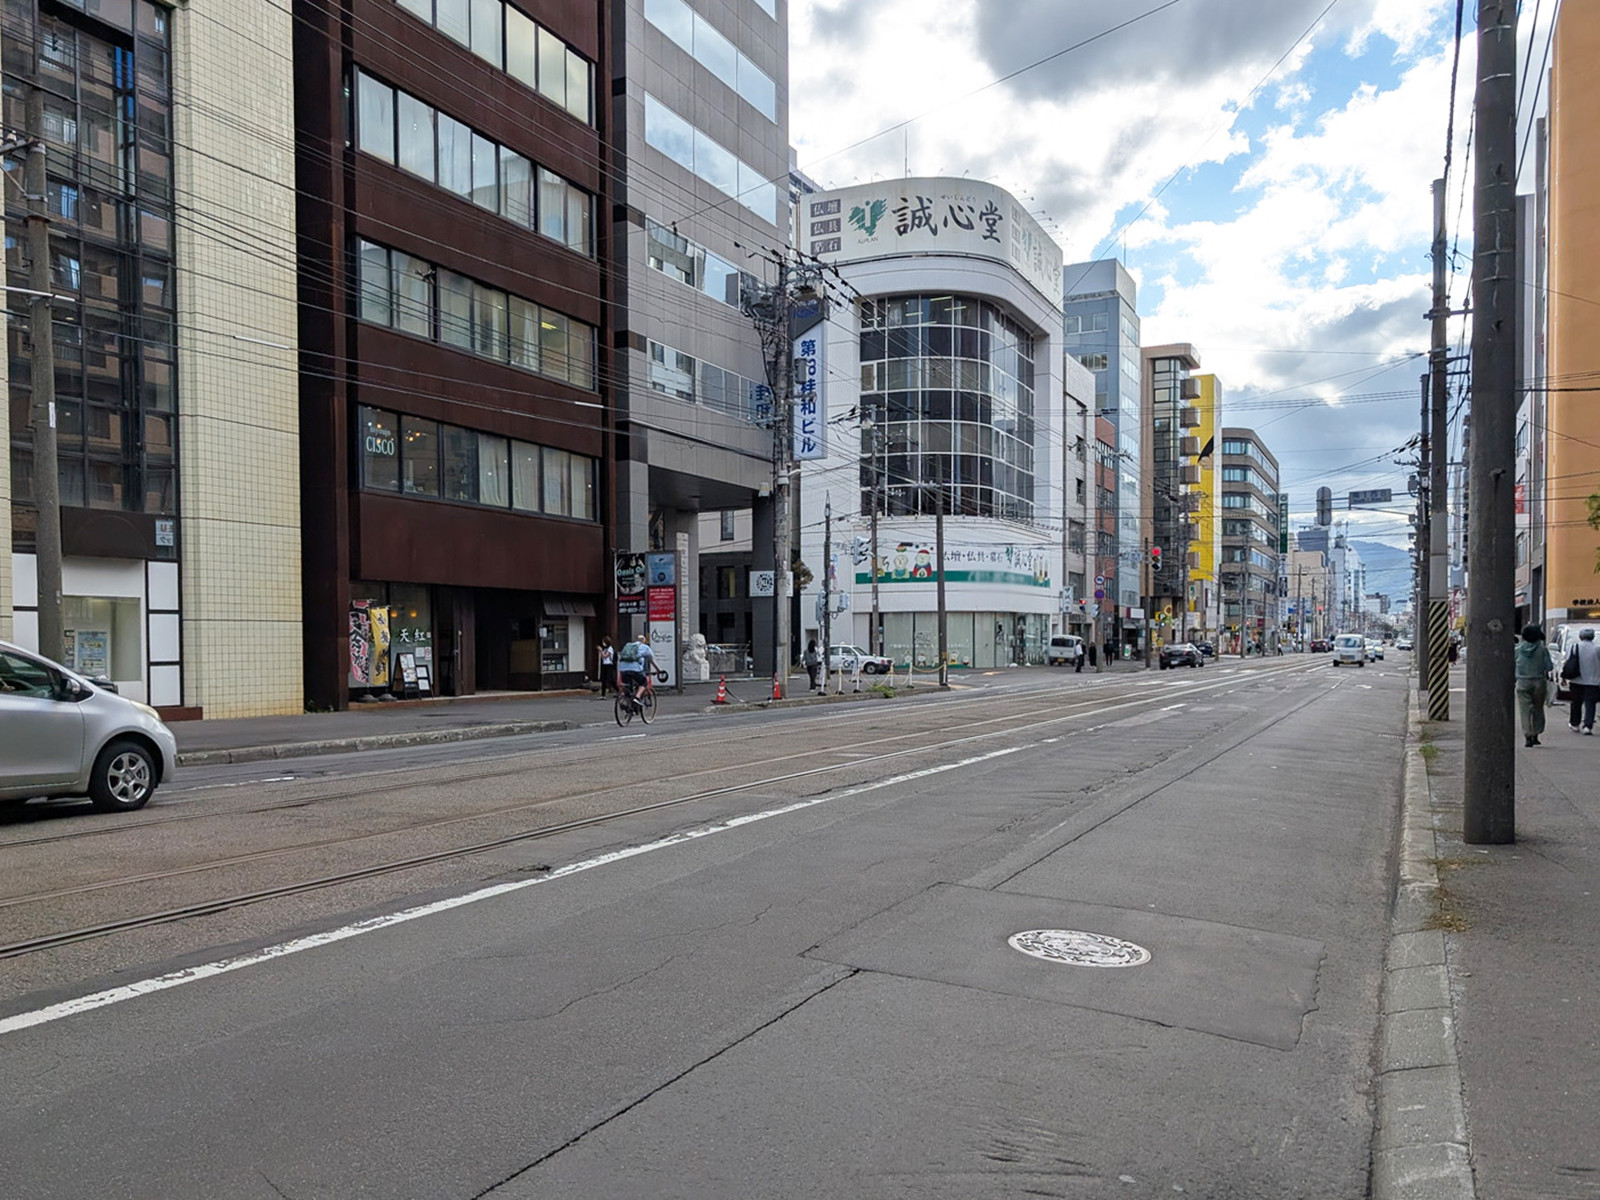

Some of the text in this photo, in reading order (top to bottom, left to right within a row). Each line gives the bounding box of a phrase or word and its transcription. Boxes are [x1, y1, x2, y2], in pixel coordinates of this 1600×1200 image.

[891, 195, 1004, 243] 誠心堂
[366, 436, 395, 456] CISCO
[400, 628, 427, 643] 天紅
